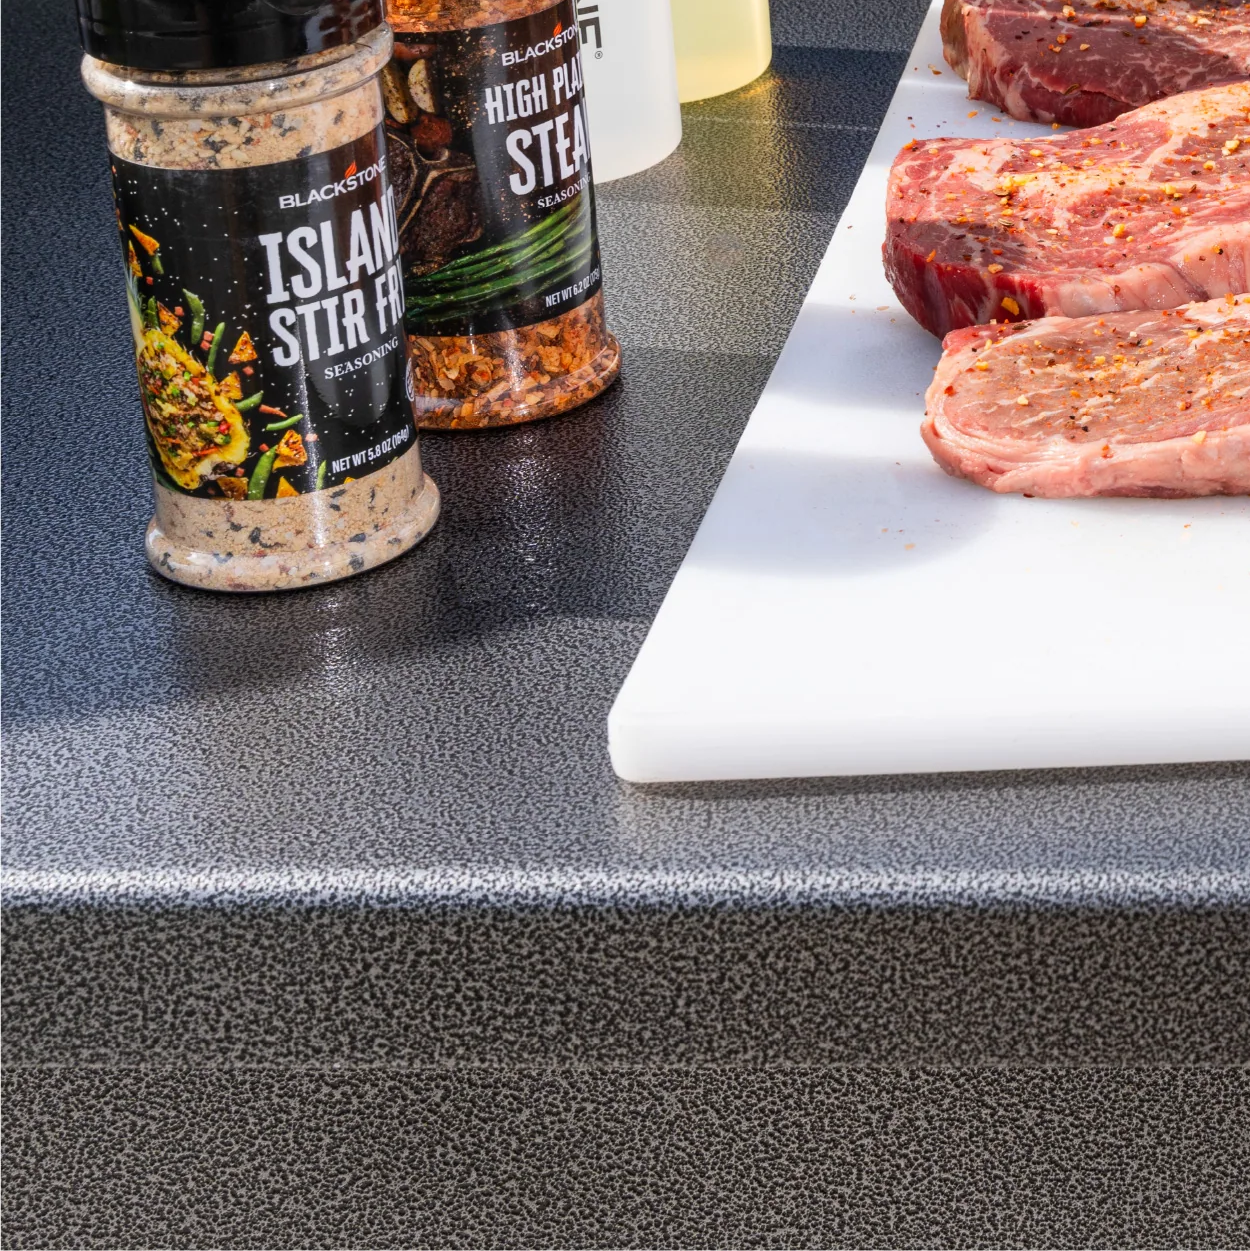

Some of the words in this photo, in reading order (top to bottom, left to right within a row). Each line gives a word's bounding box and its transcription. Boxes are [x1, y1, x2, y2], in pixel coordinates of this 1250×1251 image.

[502, 21, 578, 66] BLACKSTON
[485, 73, 549, 124] HIGH
[279, 154, 386, 209] BLACKSTONE
[537, 172, 591, 209] SEASONING
[258, 184, 400, 304] ISLAND
[545, 291, 561, 307] NET
[561, 286, 573, 301] WT
[573, 281, 583, 296] 6.2
[269, 288, 370, 367] STIR
[324, 337, 399, 380] SEASONING
[332, 456, 351, 474] NET
[352, 450, 367, 467] WT
[367, 444, 381, 461] 5.8
[381, 437, 392, 454] OZ
